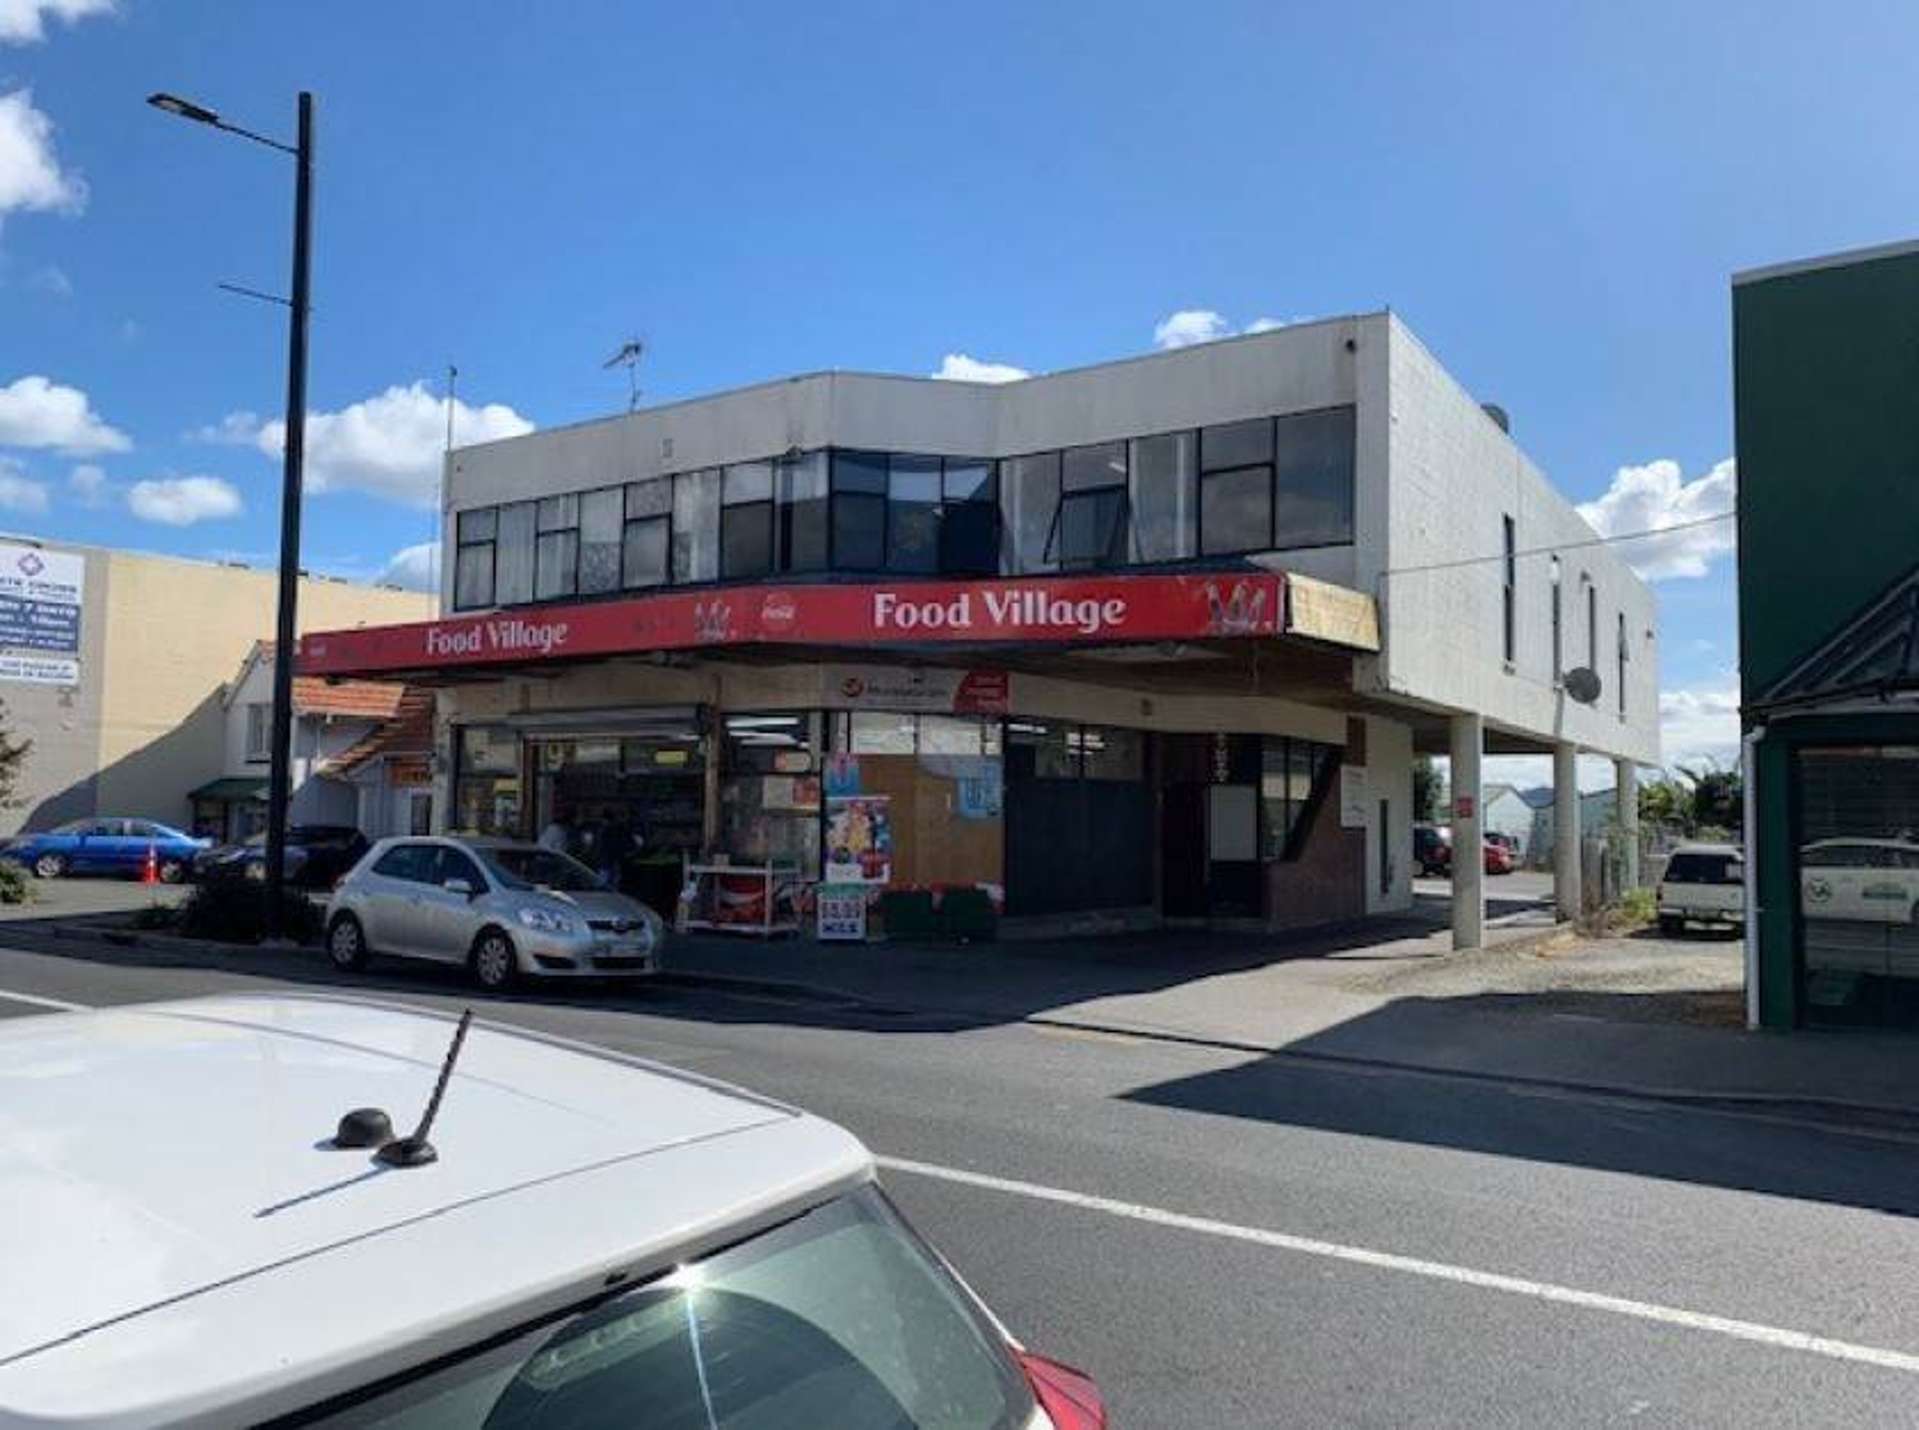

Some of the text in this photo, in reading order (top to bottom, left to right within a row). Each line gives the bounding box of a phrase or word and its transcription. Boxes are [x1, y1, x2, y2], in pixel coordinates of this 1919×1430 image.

[873, 590, 1127, 634] Food Village
[427, 620, 567, 655] Food Village
